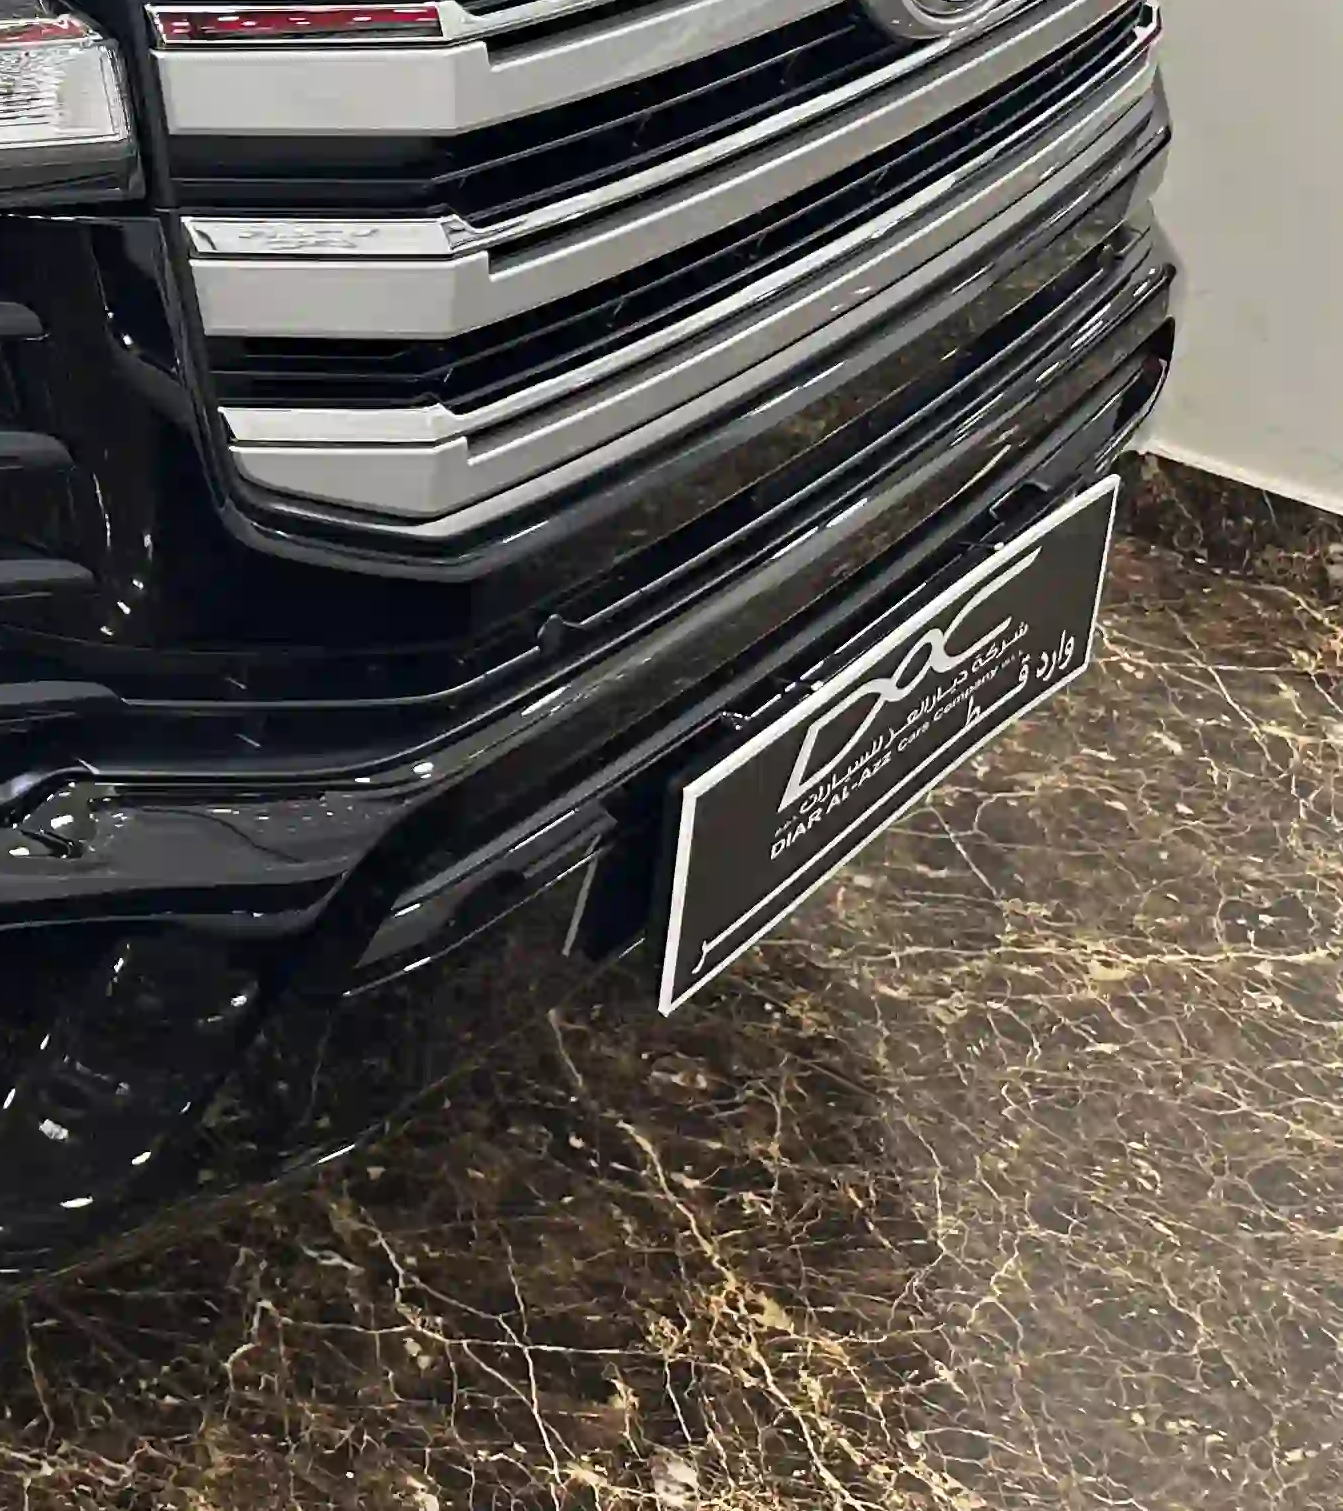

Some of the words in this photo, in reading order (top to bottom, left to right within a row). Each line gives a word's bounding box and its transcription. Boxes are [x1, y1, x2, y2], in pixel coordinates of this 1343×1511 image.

[971, 621, 1029, 672] شركة
[1036, 629, 1075, 681] وارد
[771, 807, 822, 860] DIAR
